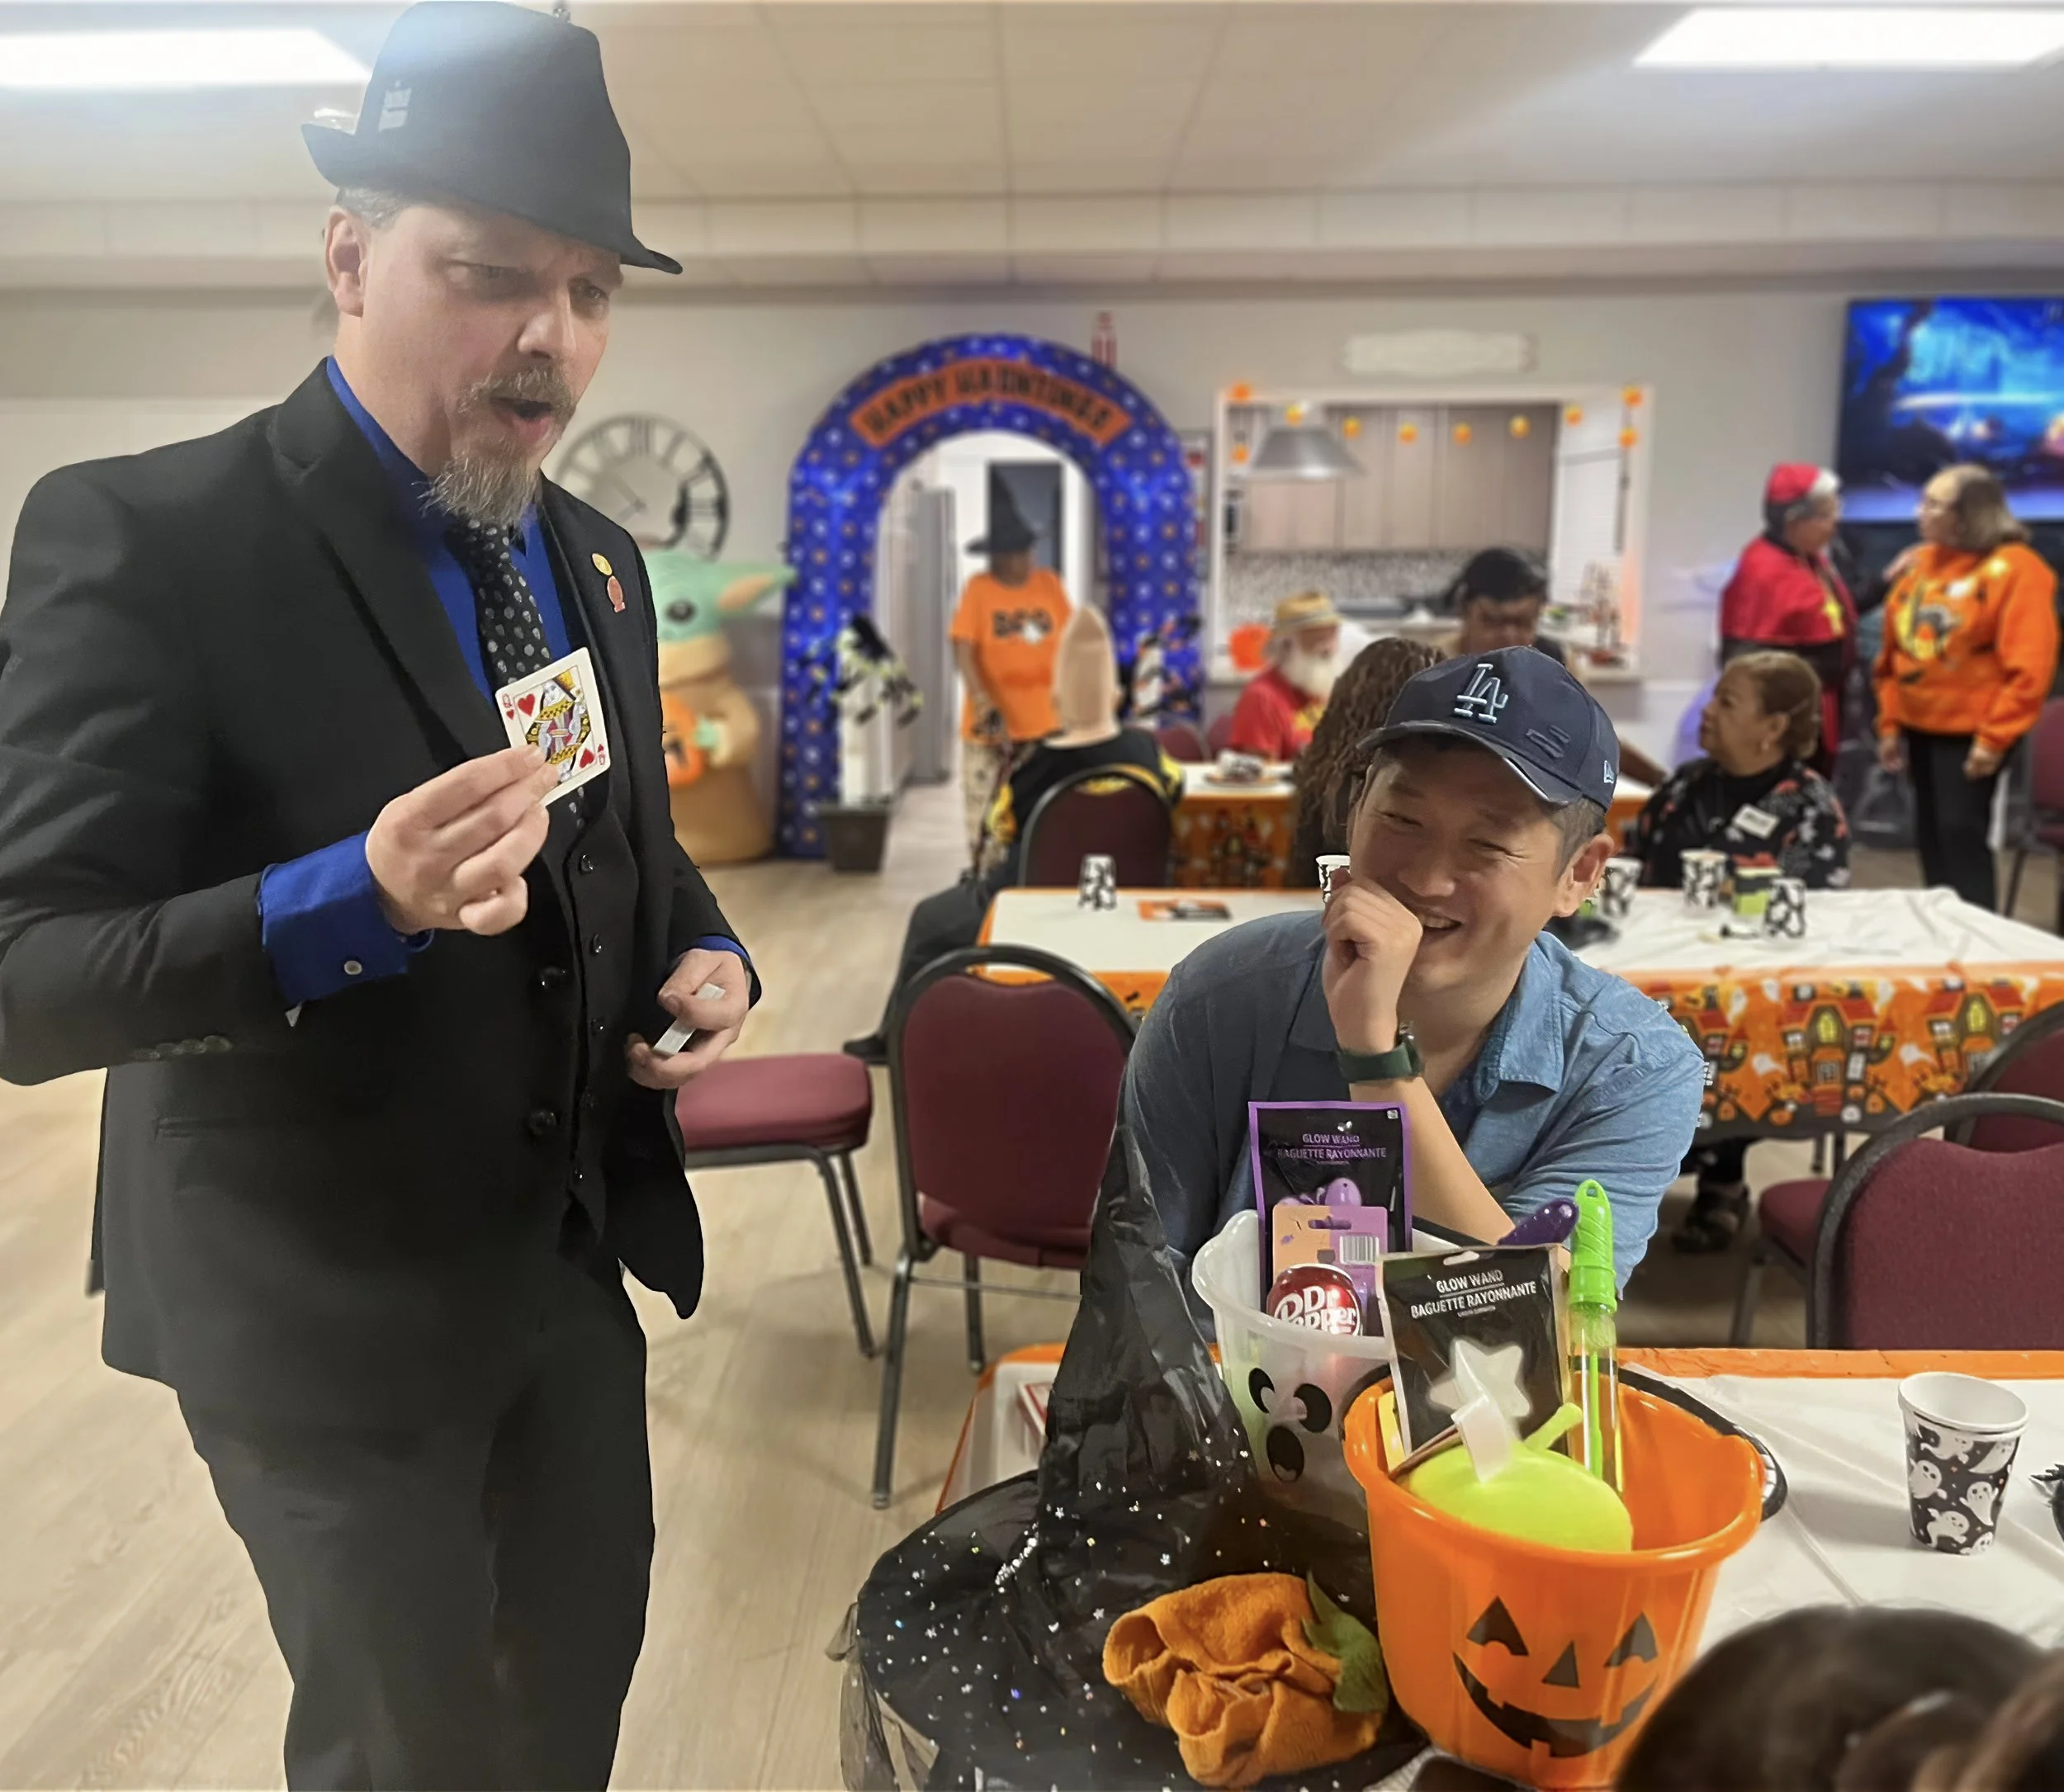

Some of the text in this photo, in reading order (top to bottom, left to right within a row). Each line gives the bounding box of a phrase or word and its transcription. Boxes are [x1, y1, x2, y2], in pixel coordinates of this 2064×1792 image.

[866, 373, 949, 436] HAPPY
[1454, 663, 1509, 724] LA
[1277, 1147, 1387, 1159] BAGUETTE RAYONNANTE
[1302, 1133, 1360, 1144] GLOW WAND
[1436, 1269, 1504, 1293] GLOW WAND
[1303, 1285, 1341, 1314] Dr
[1410, 1296, 1465, 1319] BAGUETTE
[1465, 1280, 1537, 1308] RAYONNANTE
